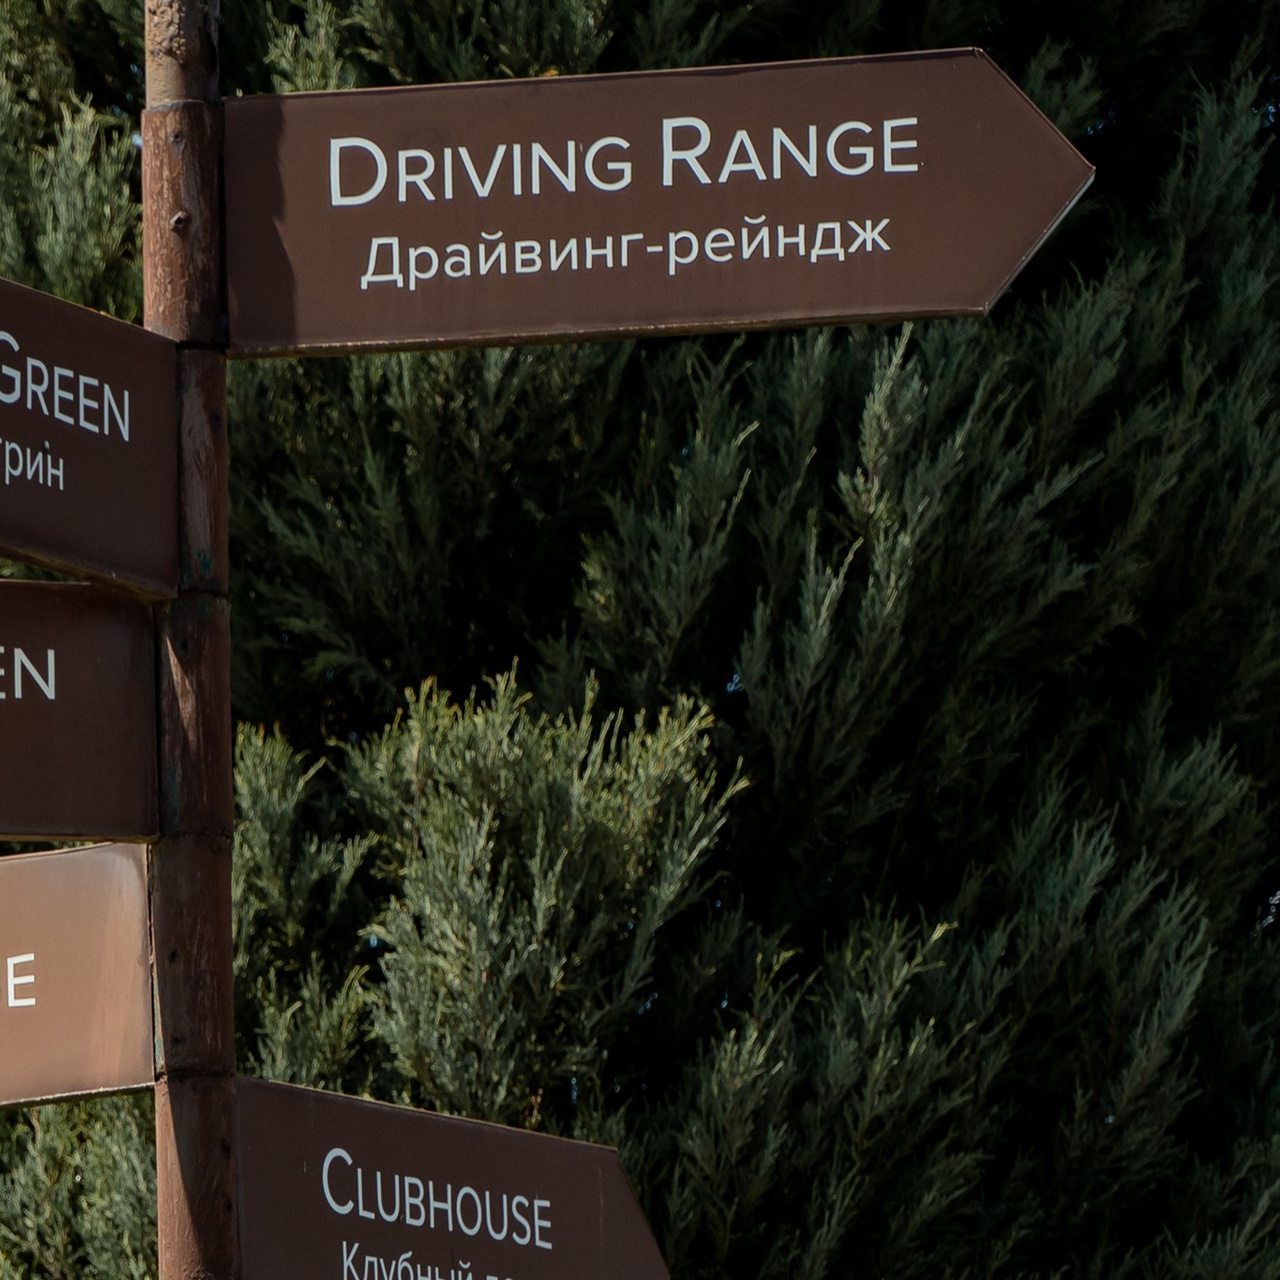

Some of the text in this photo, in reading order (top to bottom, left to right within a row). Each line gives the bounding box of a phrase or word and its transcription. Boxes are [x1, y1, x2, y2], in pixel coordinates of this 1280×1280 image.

[330, 116, 919, 206] DRIVING RANGE
[360, 214, 891, 291] Драйвинг-рейндж
[322, 1147, 553, 1250] CLUBHOUSE
